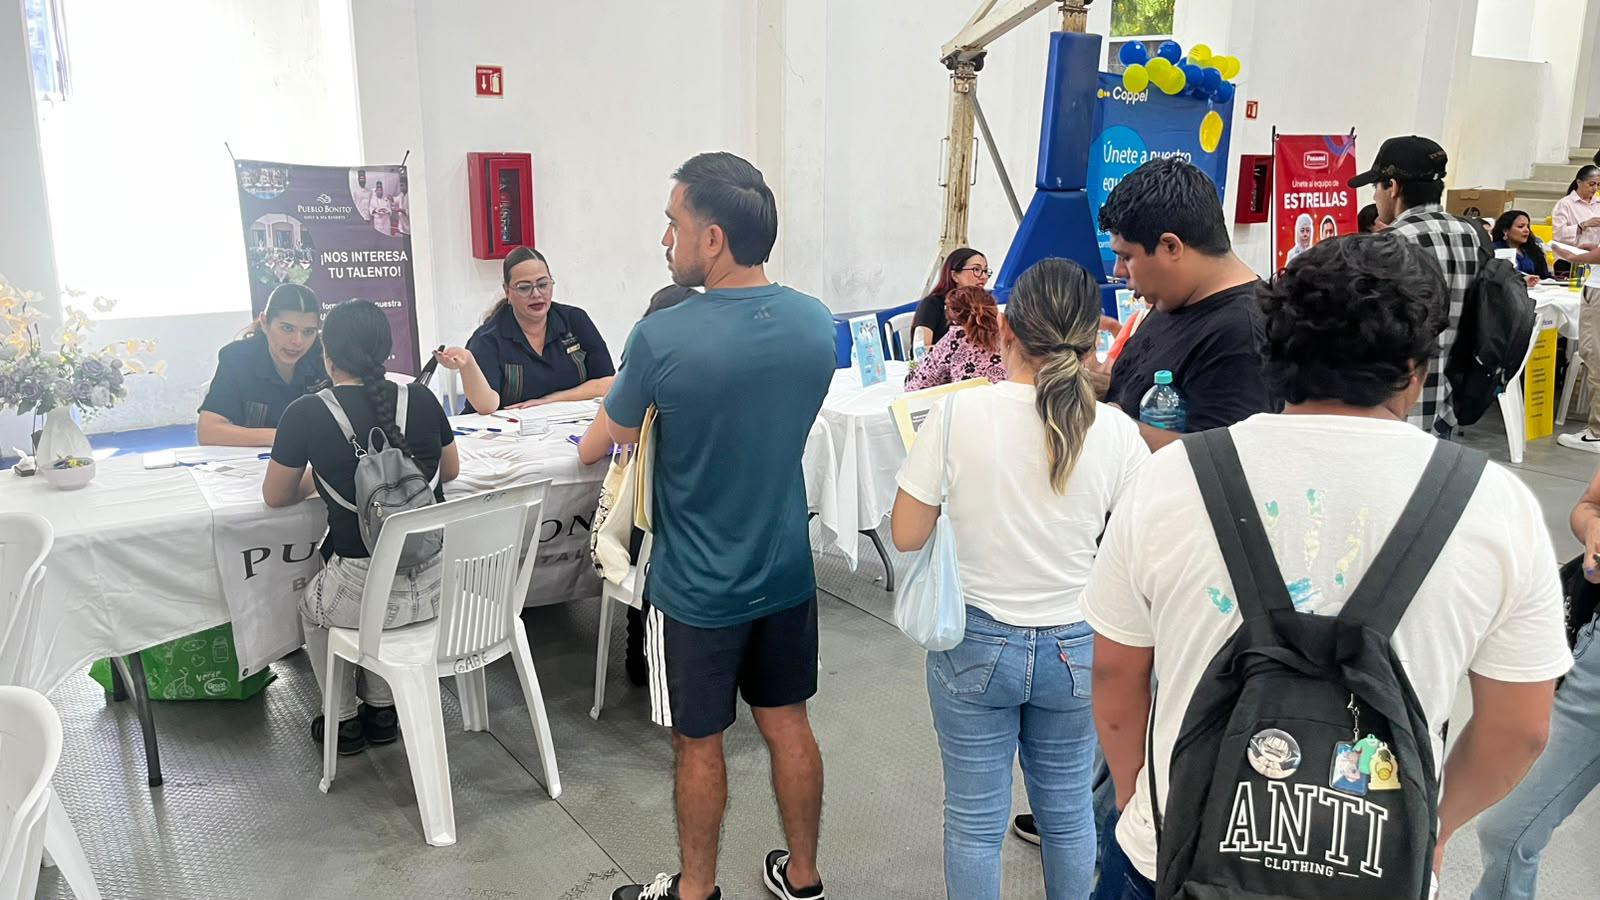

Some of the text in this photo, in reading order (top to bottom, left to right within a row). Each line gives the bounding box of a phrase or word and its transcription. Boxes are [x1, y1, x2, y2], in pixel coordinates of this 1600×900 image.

[1112, 86, 1149, 104] Coppel
[1103, 141, 1138, 164] Únete
[1140, 151, 1148, 162] a
[1314, 180, 1331, 188] equipo
[297, 205, 351, 213] PUEBLO BONITO
[1284, 191, 1348, 209] ESTRELLAS
[321, 250, 408, 265] ¡NOS INTERESA
[328, 266, 401, 279] TU TALENTO!
[1219, 780, 1388, 877] ANTI
[1264, 856, 1334, 877] CLOTHING
